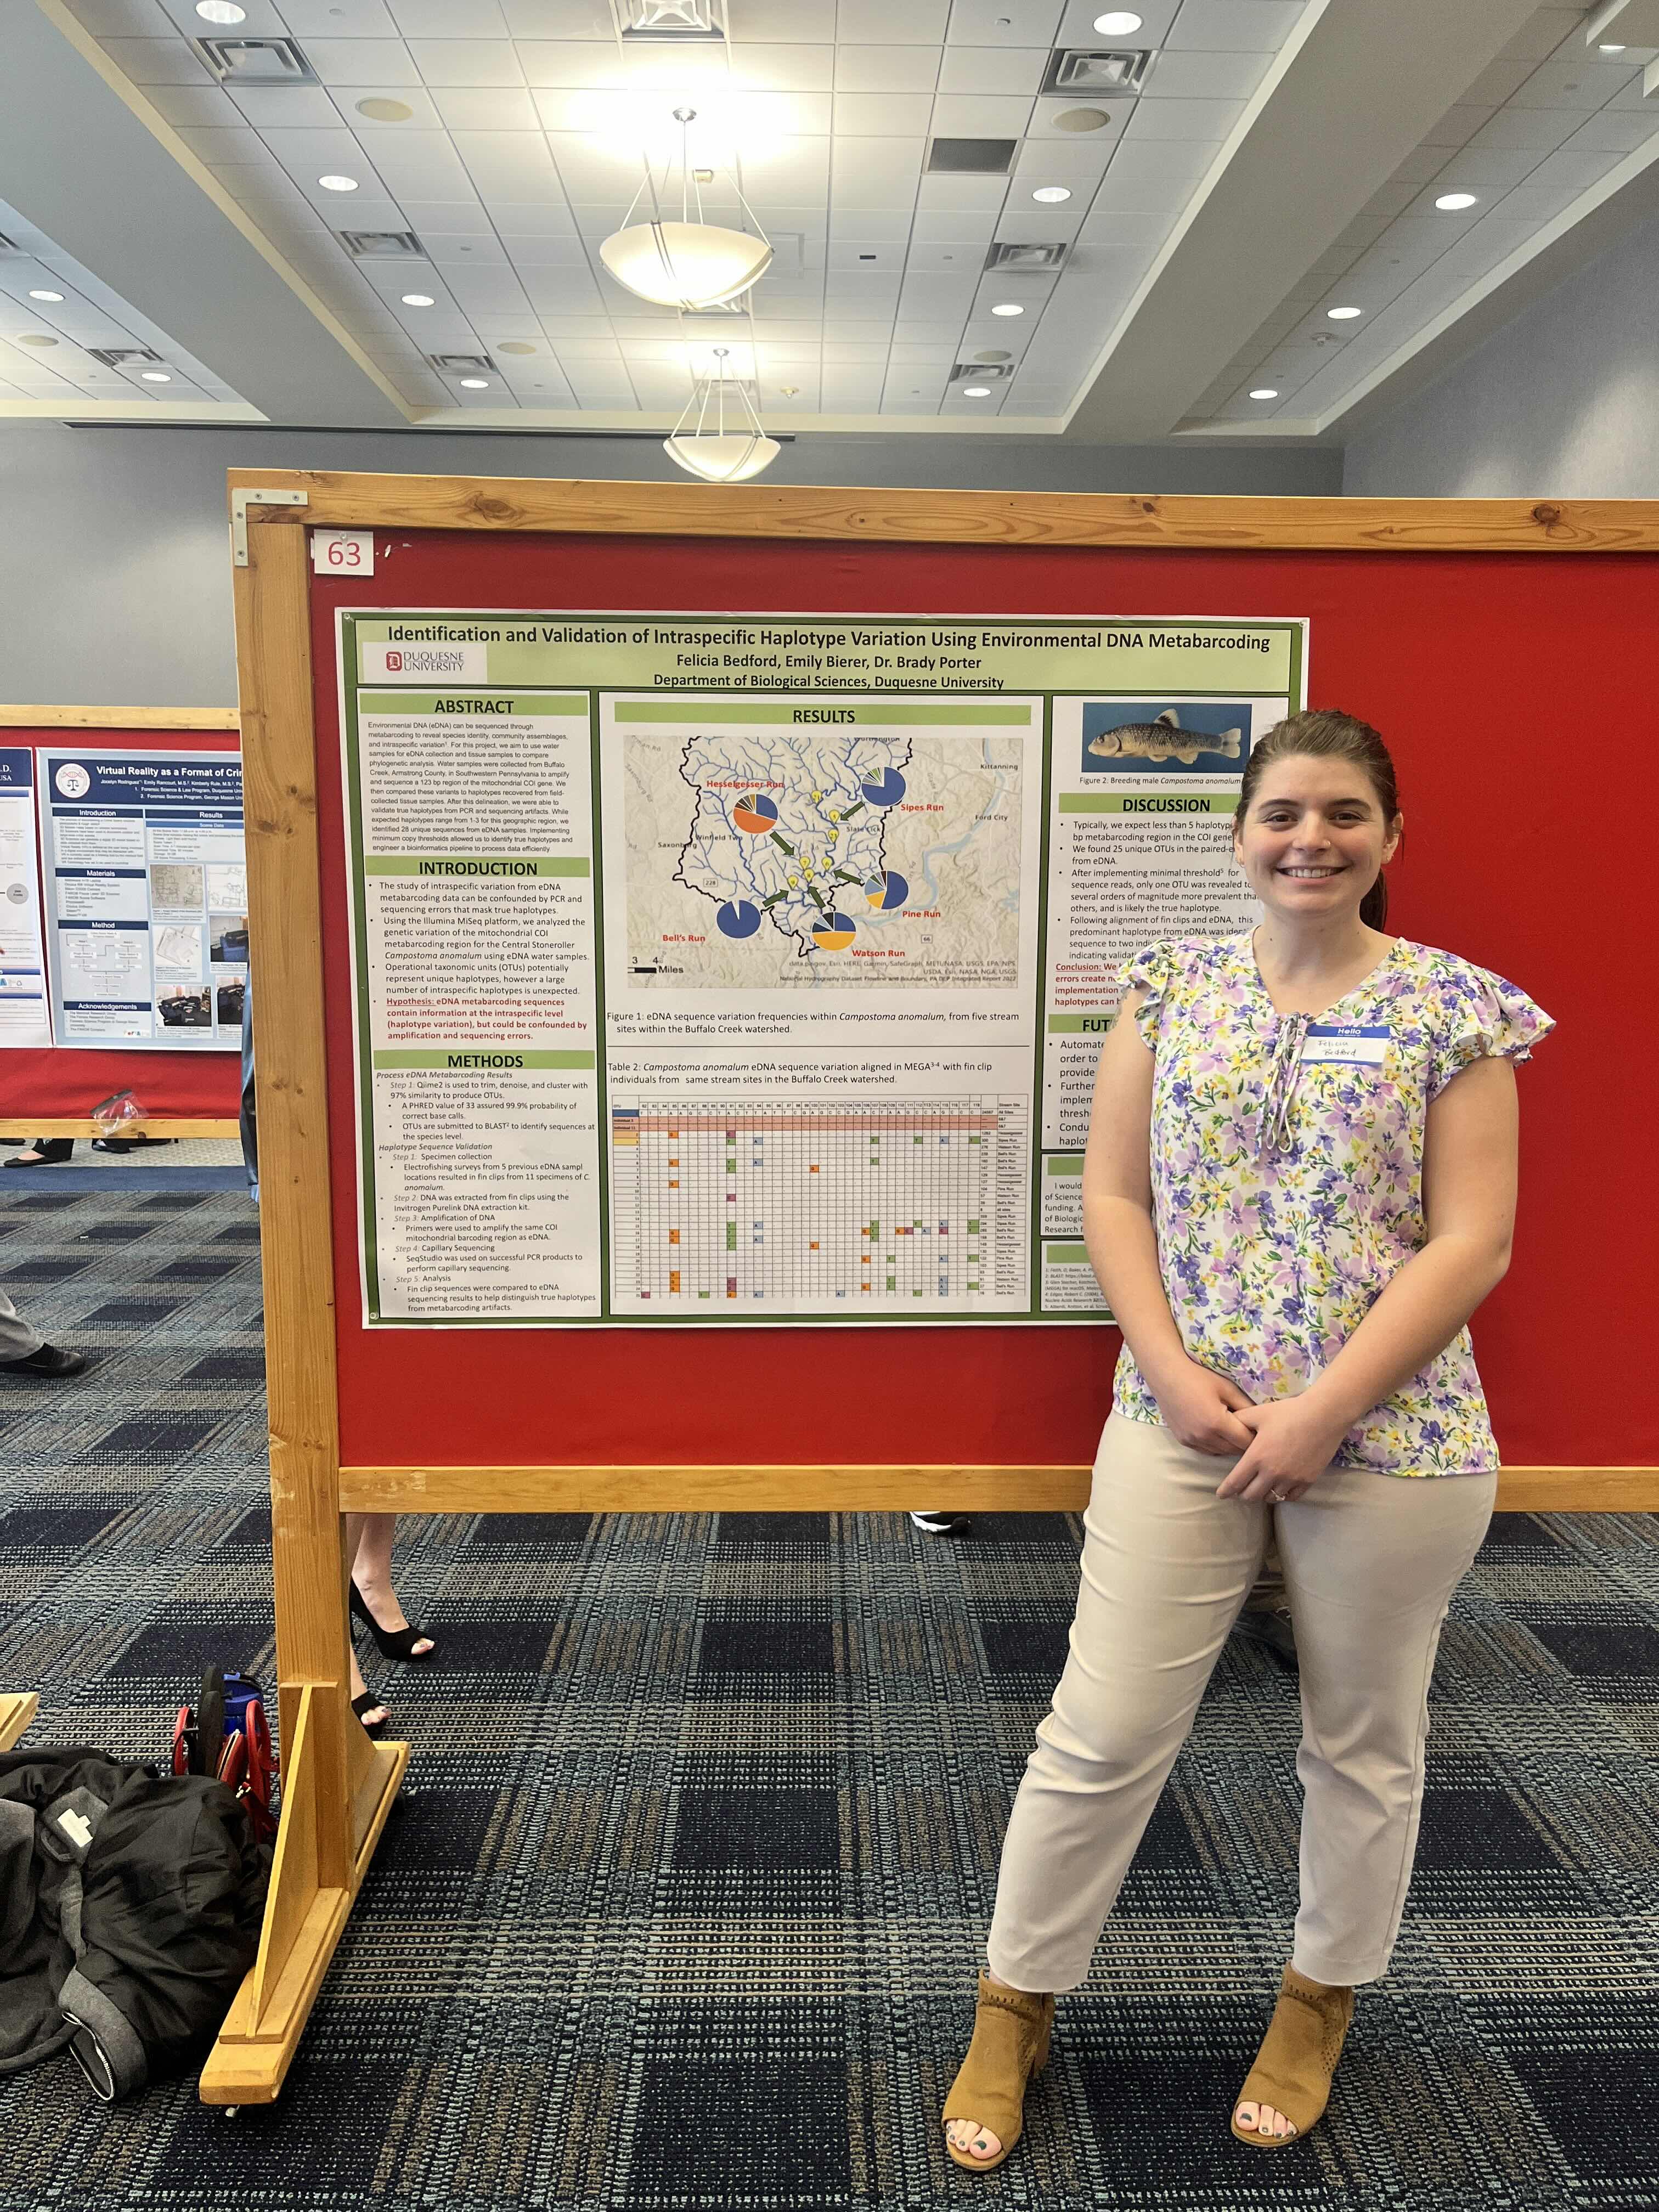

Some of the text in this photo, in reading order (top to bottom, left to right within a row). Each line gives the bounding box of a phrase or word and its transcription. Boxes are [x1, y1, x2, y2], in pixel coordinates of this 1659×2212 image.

[328, 538, 361, 566] 63
[388, 625, 1271, 652] Identification and Validation of Intraspecific Haplotype Variation Using Environmental DNA Metabarcoding
[403, 651, 464, 662] DUQUESNE
[404, 662, 464, 671] UNIVERSITY
[677, 654, 982, 671] Felicia Bedford, Emily Bierer, Dr. Brady Porter
[654, 674, 1004, 689] Department of Biological Sciences, Duquesne University
[434, 700, 514, 713] ABSTRACT
[793, 710, 855, 723] RESULTS
[96, 766, 126, 775] Virtual
[128, 767, 159, 777] Reality
[181, 768, 213, 776] Format
[215, 769, 224, 777] of
[707, 780, 762, 789] Hesselgesser
[900, 804, 923, 812] Sipes
[1123, 799, 1210, 811] DISCUSSION
[1073, 821, 1108, 830] Typically,
[419, 862, 537, 875] INTRODUCTION
[78, 1003, 137, 1011] Acknowledgements
[387, 997, 436, 1006] Hypothesis:
[461, 998, 522, 1007] metabarcoding
[495, 1009, 543, 1018] intraspecific
[607, 1013, 634, 1022] Figure
[758, 1012, 808, 1022] frequencies
[839, 1013, 896, 1022] Campostoma
[898, 1013, 946, 1022] anomalum,
[387, 1020, 432, 1030] (haplotype
[433, 1020, 475, 1029] variation),
[577, 1021, 587, 1030] by
[388, 1032, 441, 1040] amplification
[448, 1056, 523, 1067] METHODS
[644, 1063, 701, 1073] Campostoma
[861, 1062, 891, 1072] aligned
[977, 1063, 992, 1072] clip
[1060, 1068, 1095, 1078] provide
[610, 1075, 657, 1083] individuals
[658, 1075, 680, 1083] from
[775, 1075, 789, 1084] the
[792, 1075, 822, 1083] Buffalo
[1060, 1082, 1096, 1090] Further
[408, 1295, 448, 1304] sequencing
[557, 1294, 596, 1302] haplotypes
